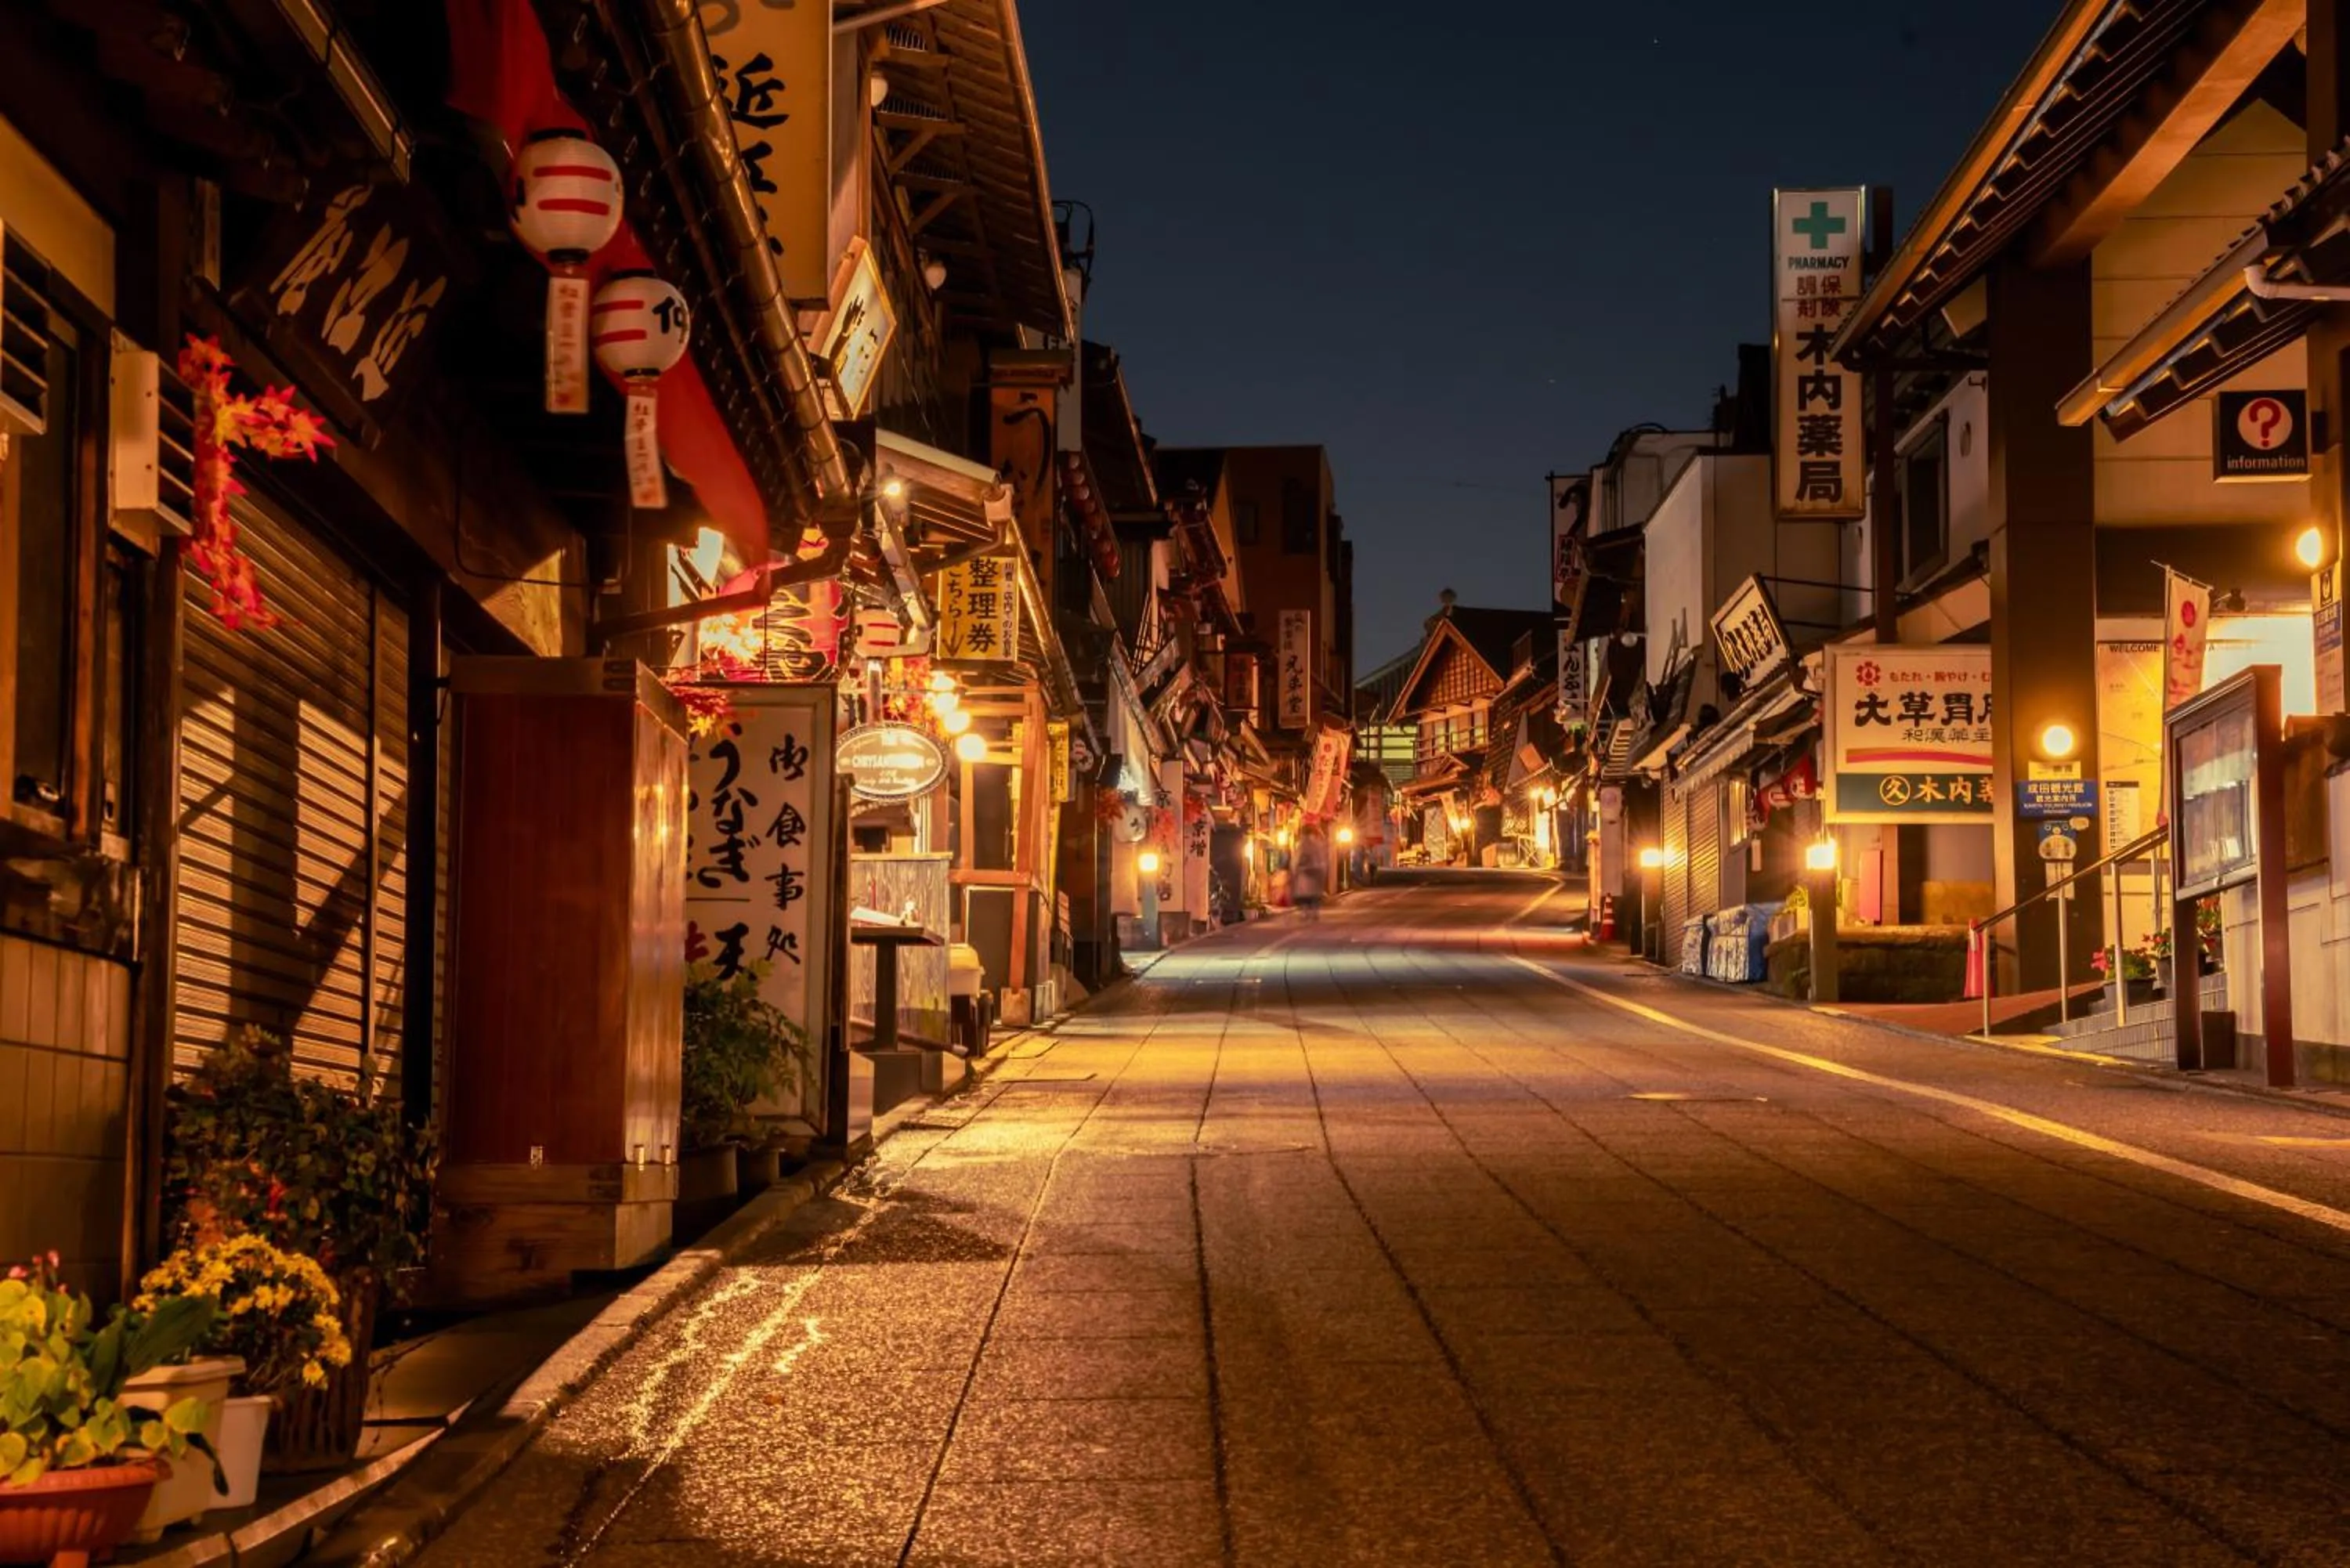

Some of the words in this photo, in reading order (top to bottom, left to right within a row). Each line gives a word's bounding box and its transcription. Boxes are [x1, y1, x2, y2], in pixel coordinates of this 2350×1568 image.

[1788, 255, 1849, 270] PHARMACY
[1795, 323, 1843, 504] 木内薬局
[2225, 453, 2306, 471] information
[947, 569, 963, 619] こちら
[967, 557, 999, 653] 整理券
[2109, 643, 2160, 653] WELCOME
[697, 722, 761, 889] うなぎ
[765, 733, 809, 965] 御食事処
